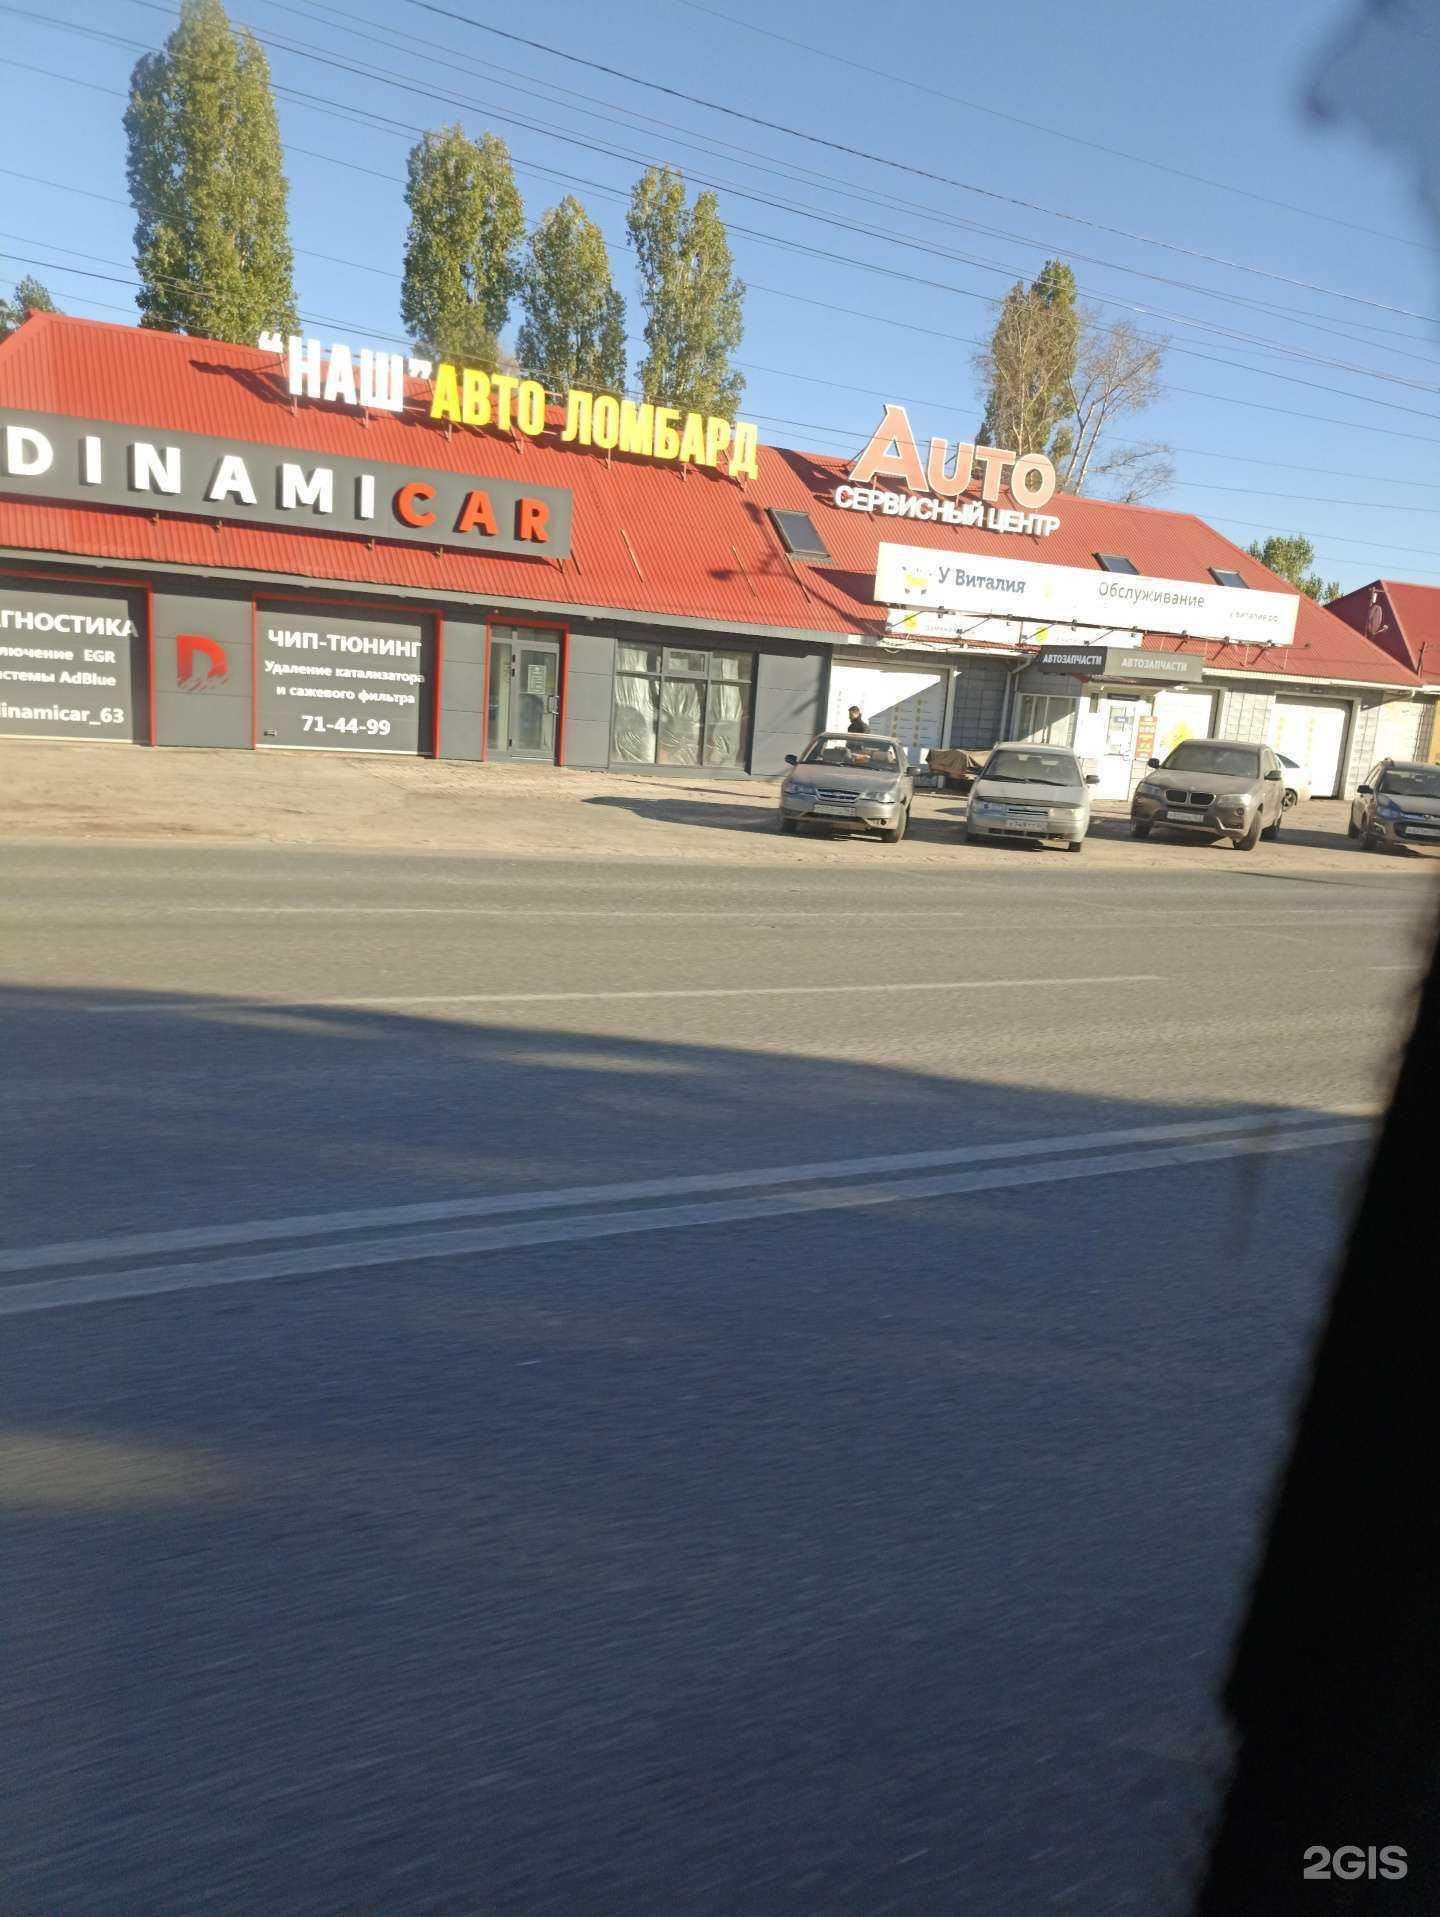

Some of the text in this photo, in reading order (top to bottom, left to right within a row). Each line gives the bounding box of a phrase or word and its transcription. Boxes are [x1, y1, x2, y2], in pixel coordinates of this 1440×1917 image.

[430, 364, 545, 436] АВТО
[561, 388, 759, 481] ЛОМБАРД
[835, 484, 1061, 537] СЕРВИСНЫЙ ЦЕНТР
[937, 566, 1026, 594] У Виталия
[1098, 577, 1205, 608] Обслуживание
[0, 609, 138, 638] ГНОСТИКА
[83, 648, 117, 664] EGR
[267, 629, 422, 658] ЧИП-ТЮНИНГ
[1042, 653, 1103, 666] АВТОЗАПЧАСТИ
[1121, 657, 1188, 672] АВТОЗАПЧАСТИ
[59, 670, 117, 686] AdBlue
[264, 660, 425, 685] Удаление катализатора
[276, 685, 416, 705] и сажевого фильтра
[0, 701, 125, 726] inamicar_63
[301, 714, 391, 736] 71-44-99
